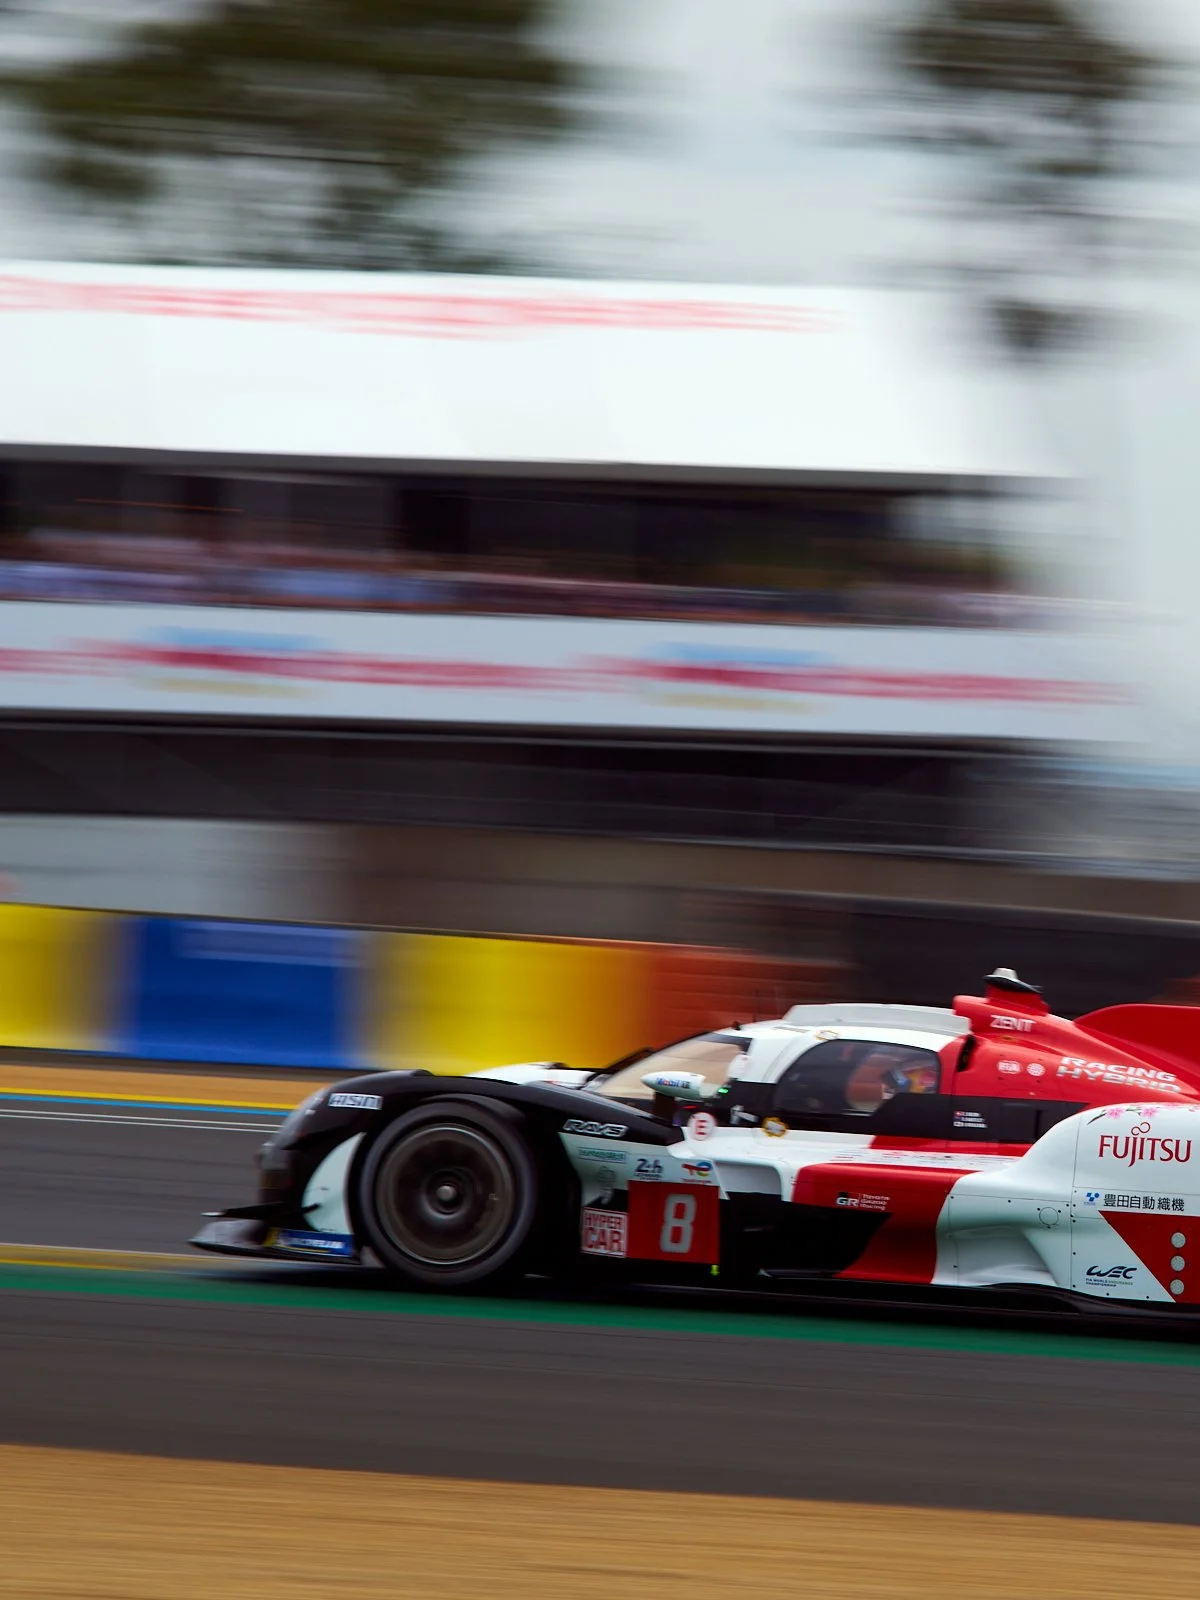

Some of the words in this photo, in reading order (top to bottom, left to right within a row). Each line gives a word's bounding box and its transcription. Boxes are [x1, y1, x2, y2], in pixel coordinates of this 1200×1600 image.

[990, 1014, 1037, 1033] ZENT
[1059, 1056, 1178, 1083] RACING
[1055, 1066, 1182, 1094] HYBRID
[562, 1118, 629, 1138] RAYS
[695, 1119, 707, 1136] E
[1098, 1121, 1192, 1167] FUJITSU
[836, 1196, 859, 1207] GR
[584, 1211, 624, 1229] HYPER
[660, 1194, 697, 1253] 8
[584, 1227, 623, 1250] CAR
[1086, 1265, 1137, 1279] WEC
